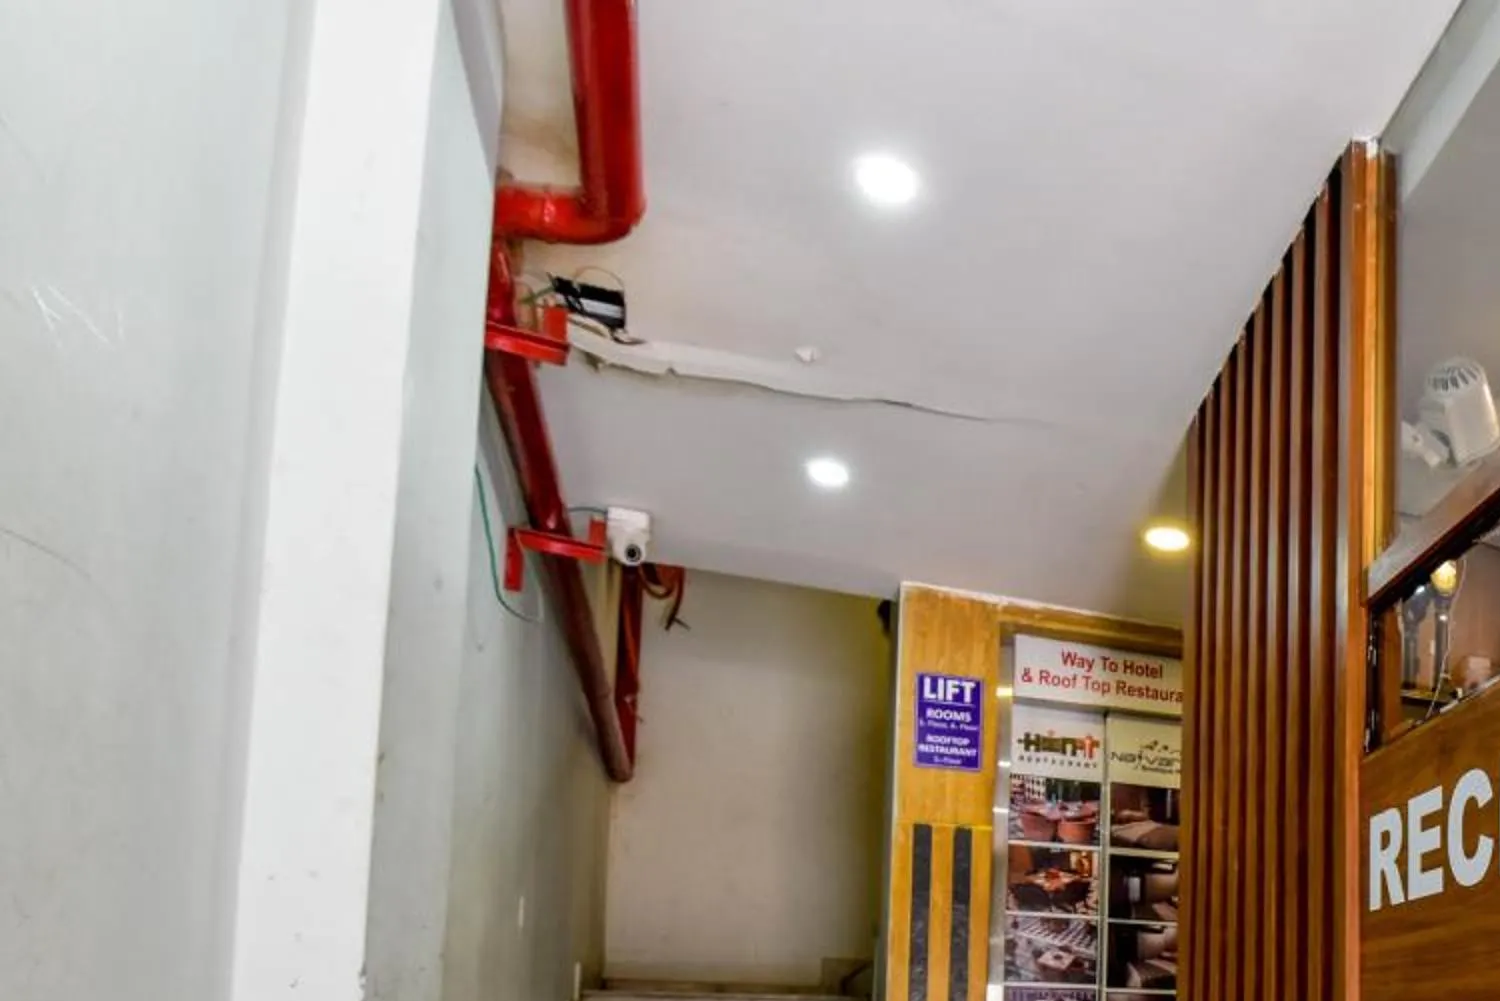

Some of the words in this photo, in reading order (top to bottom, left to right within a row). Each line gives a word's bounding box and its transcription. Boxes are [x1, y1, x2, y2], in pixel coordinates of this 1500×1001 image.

[1061, 649, 1096, 673] Way
[1101, 656, 1119, 673] To
[1123, 659, 1163, 680] Hotel
[923, 676, 976, 704] LIFT
[1021, 667, 1033, 684] &
[1039, 669, 1077, 689] Roof
[1082, 675, 1111, 696] Top
[925, 707, 972, 723] ROOMS
